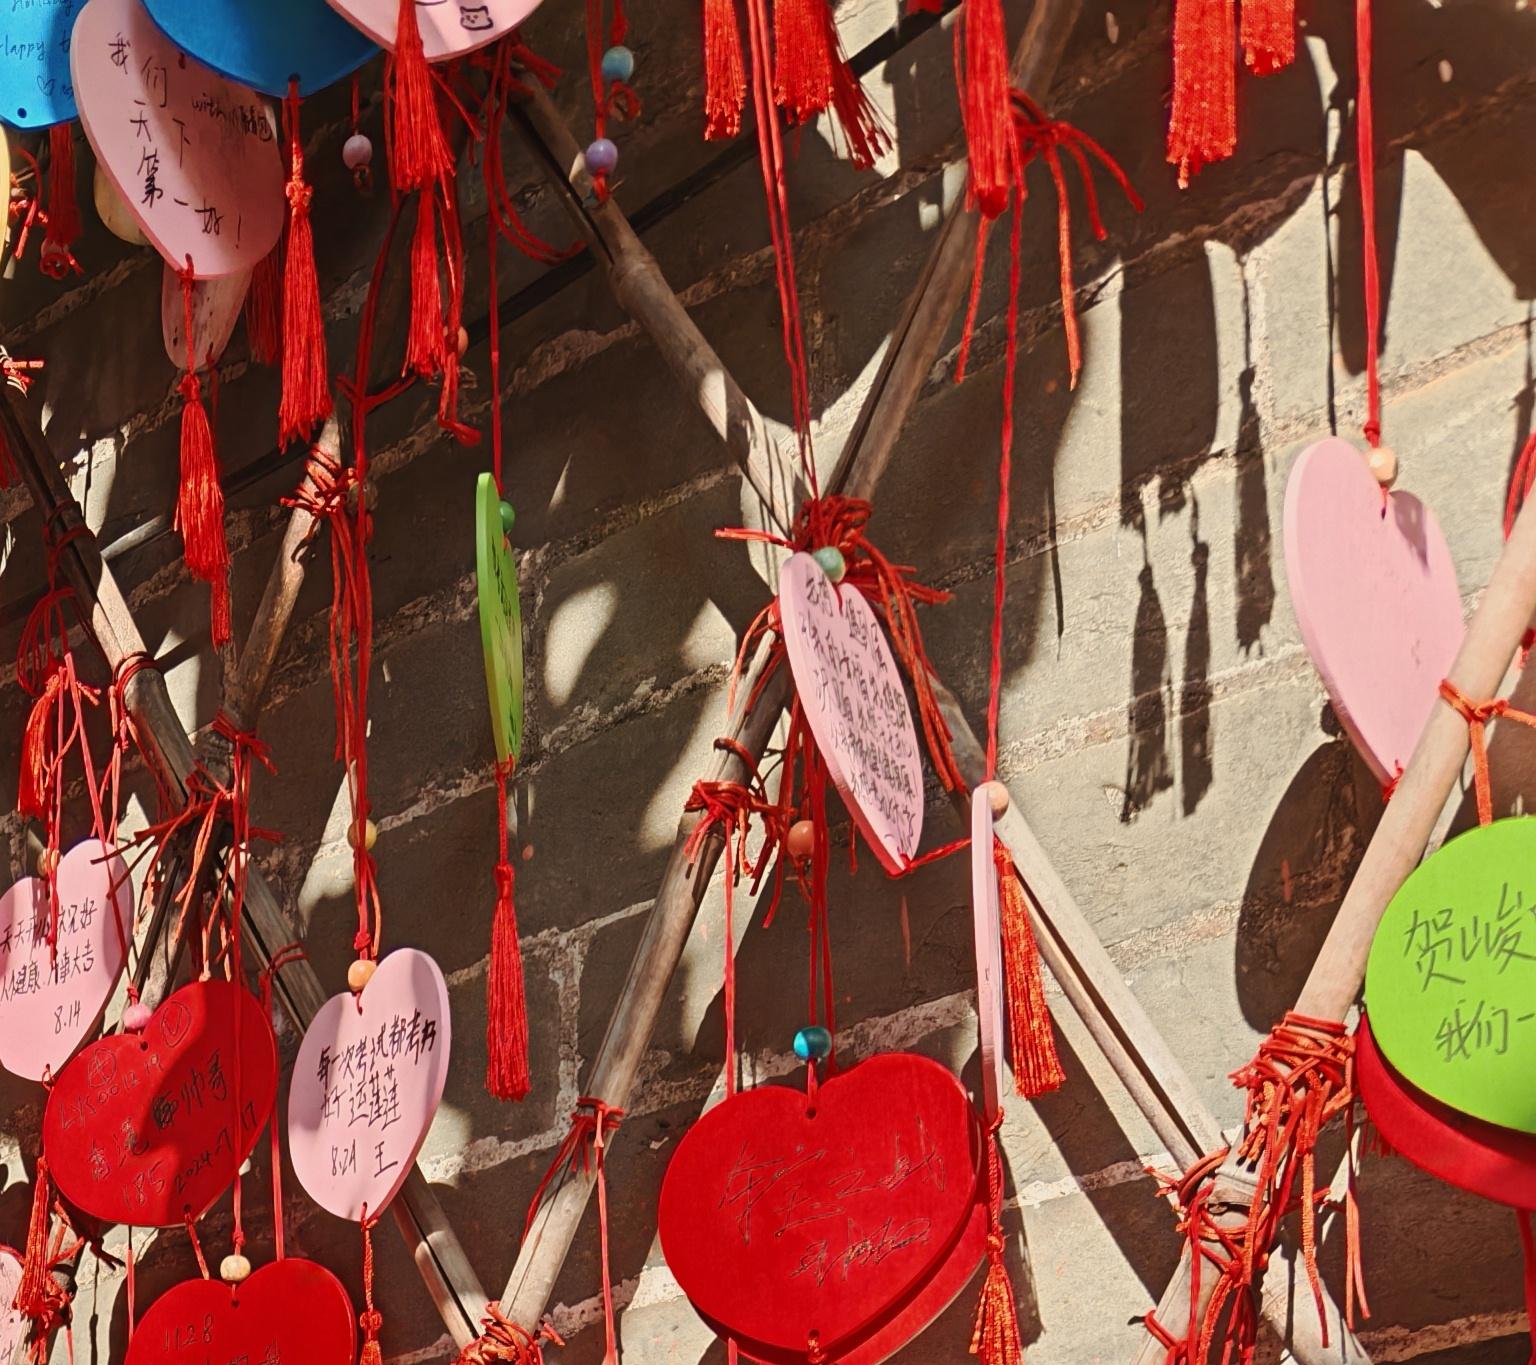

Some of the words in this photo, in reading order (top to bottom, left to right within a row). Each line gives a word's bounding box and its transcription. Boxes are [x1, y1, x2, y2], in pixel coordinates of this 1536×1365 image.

[108, 32, 168, 107] 我们
[1404, 881, 1536, 993] 贺峻
[54, 1000, 81, 1035] 8.14
